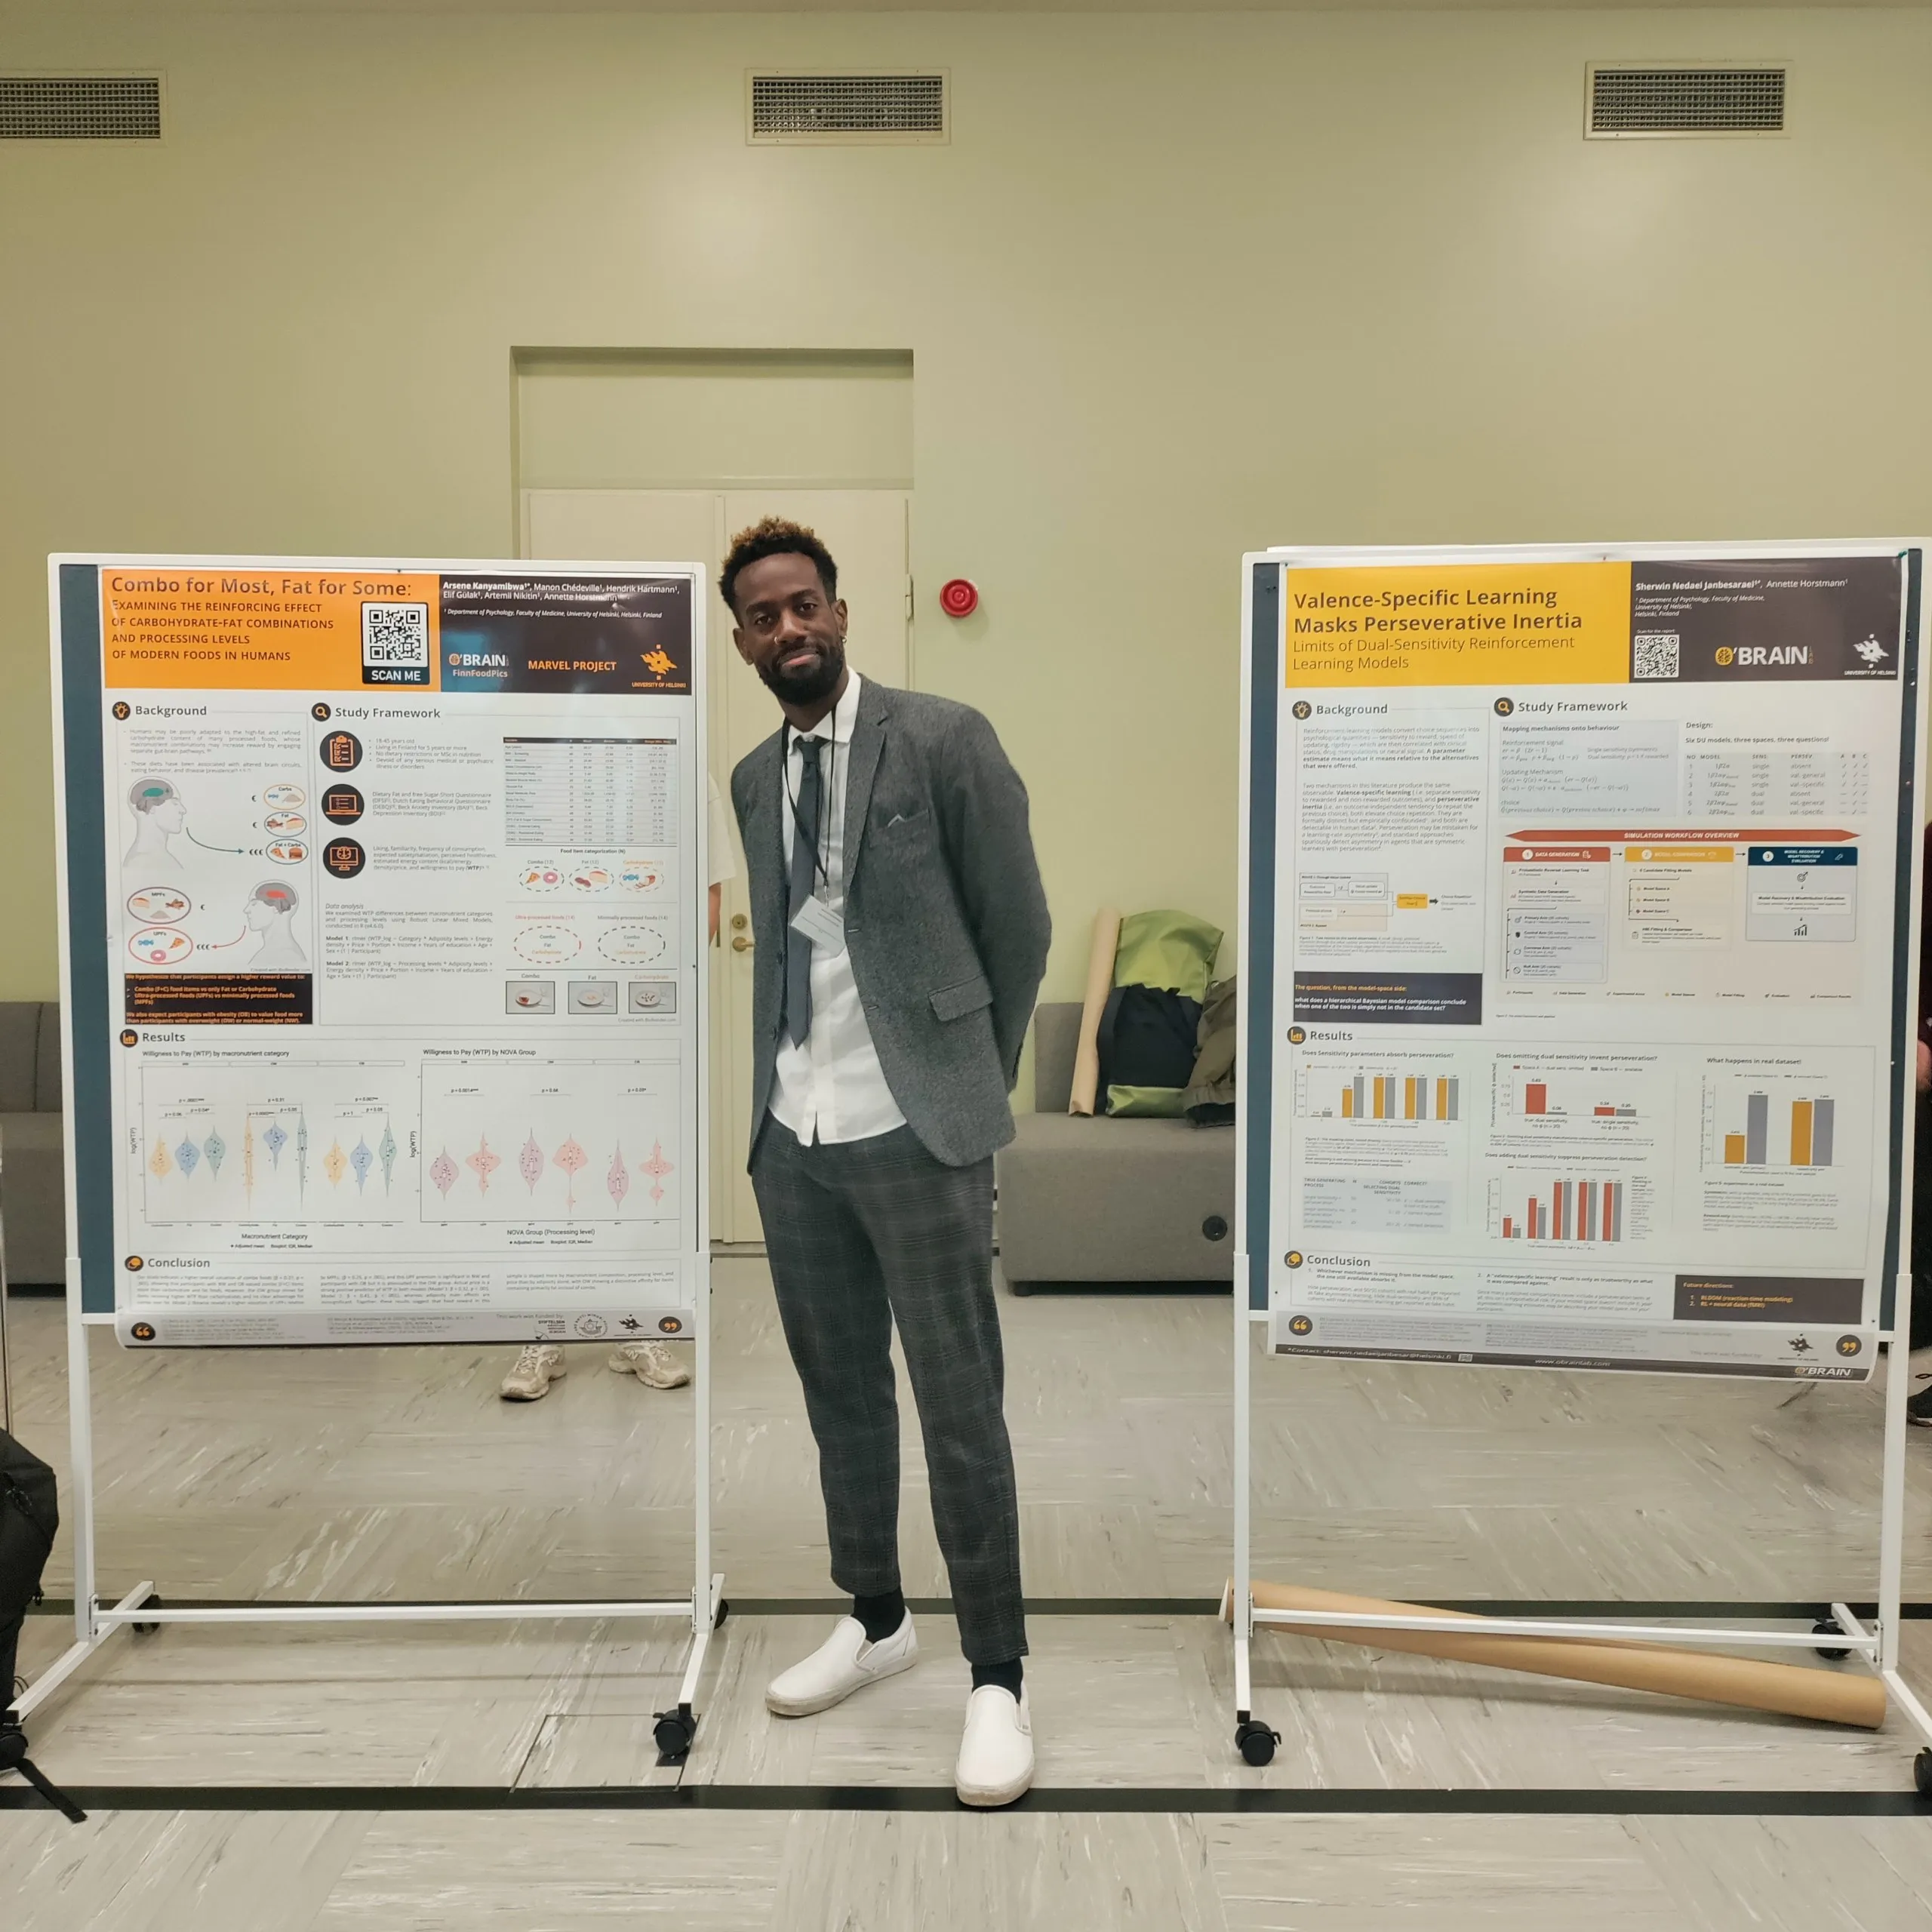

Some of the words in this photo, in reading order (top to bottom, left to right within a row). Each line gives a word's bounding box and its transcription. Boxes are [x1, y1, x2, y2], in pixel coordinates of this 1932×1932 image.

[111, 577, 180, 592] Combo
[186, 577, 214, 592] for
[221, 578, 274, 596] Most,
[281, 579, 312, 594] Fat
[318, 578, 346, 595] for
[352, 580, 411, 595] Some:
[606, 584, 635, 592] Hendrik
[1635, 583, 1670, 591] Sherwin
[1766, 580, 1798, 588] Annette
[1294, 589, 1459, 610] Valence-Specific
[1466, 587, 1557, 607] Learning
[111, 599, 177, 611] EXAMINING
[180, 601, 201, 611] THE
[205, 601, 280, 612] REINFORCING
[284, 603, 322, 612] EFFECT
[111, 617, 125, 627] OF
[129, 617, 242, 627] CARBOHYDRATE-FAT
[246, 618, 334, 629] COMBINATIONS
[1294, 616, 1357, 633] Masks
[1364, 613, 1506, 631] Perseverative
[1513, 612, 1581, 629] Inertia
[112, 633, 135, 642] AND
[140, 634, 208, 644] PROCESSING
[212, 635, 250, 644] LEVELS
[1294, 640, 1334, 652] Limits
[1338, 638, 1353, 651] of
[1357, 637, 1465, 653] Dual-Sensitivity
[1469, 635, 1574, 649] Reinforcement
[112, 650, 126, 659] OF
[130, 650, 179, 659] MODERN
[183, 651, 220, 660] FOODS
[224, 651, 236, 660] IN
[241, 651, 291, 660] HUMANS
[528, 660, 571, 670] MARVEL
[573, 660, 617, 672] PROJECT
[1293, 657, 1353, 672] Learning
[1358, 655, 1408, 669] Models
[371, 669, 401, 681] SCAN
[404, 670, 421, 681] ME
[453, 669, 508, 678] FinnFoodPics
[135, 705, 207, 718] Background
[1316, 703, 1387, 717] Background
[1518, 701, 1553, 714] Study
[1557, 700, 1627, 711] Framework
[335, 707, 369, 720] Study
[373, 708, 440, 718] Framework
[142, 1032, 185, 1041] Results
[1310, 1030, 1352, 1041] Results
[147, 1257, 210, 1267] Conclusion
[1306, 1254, 1370, 1266] Conclusion
